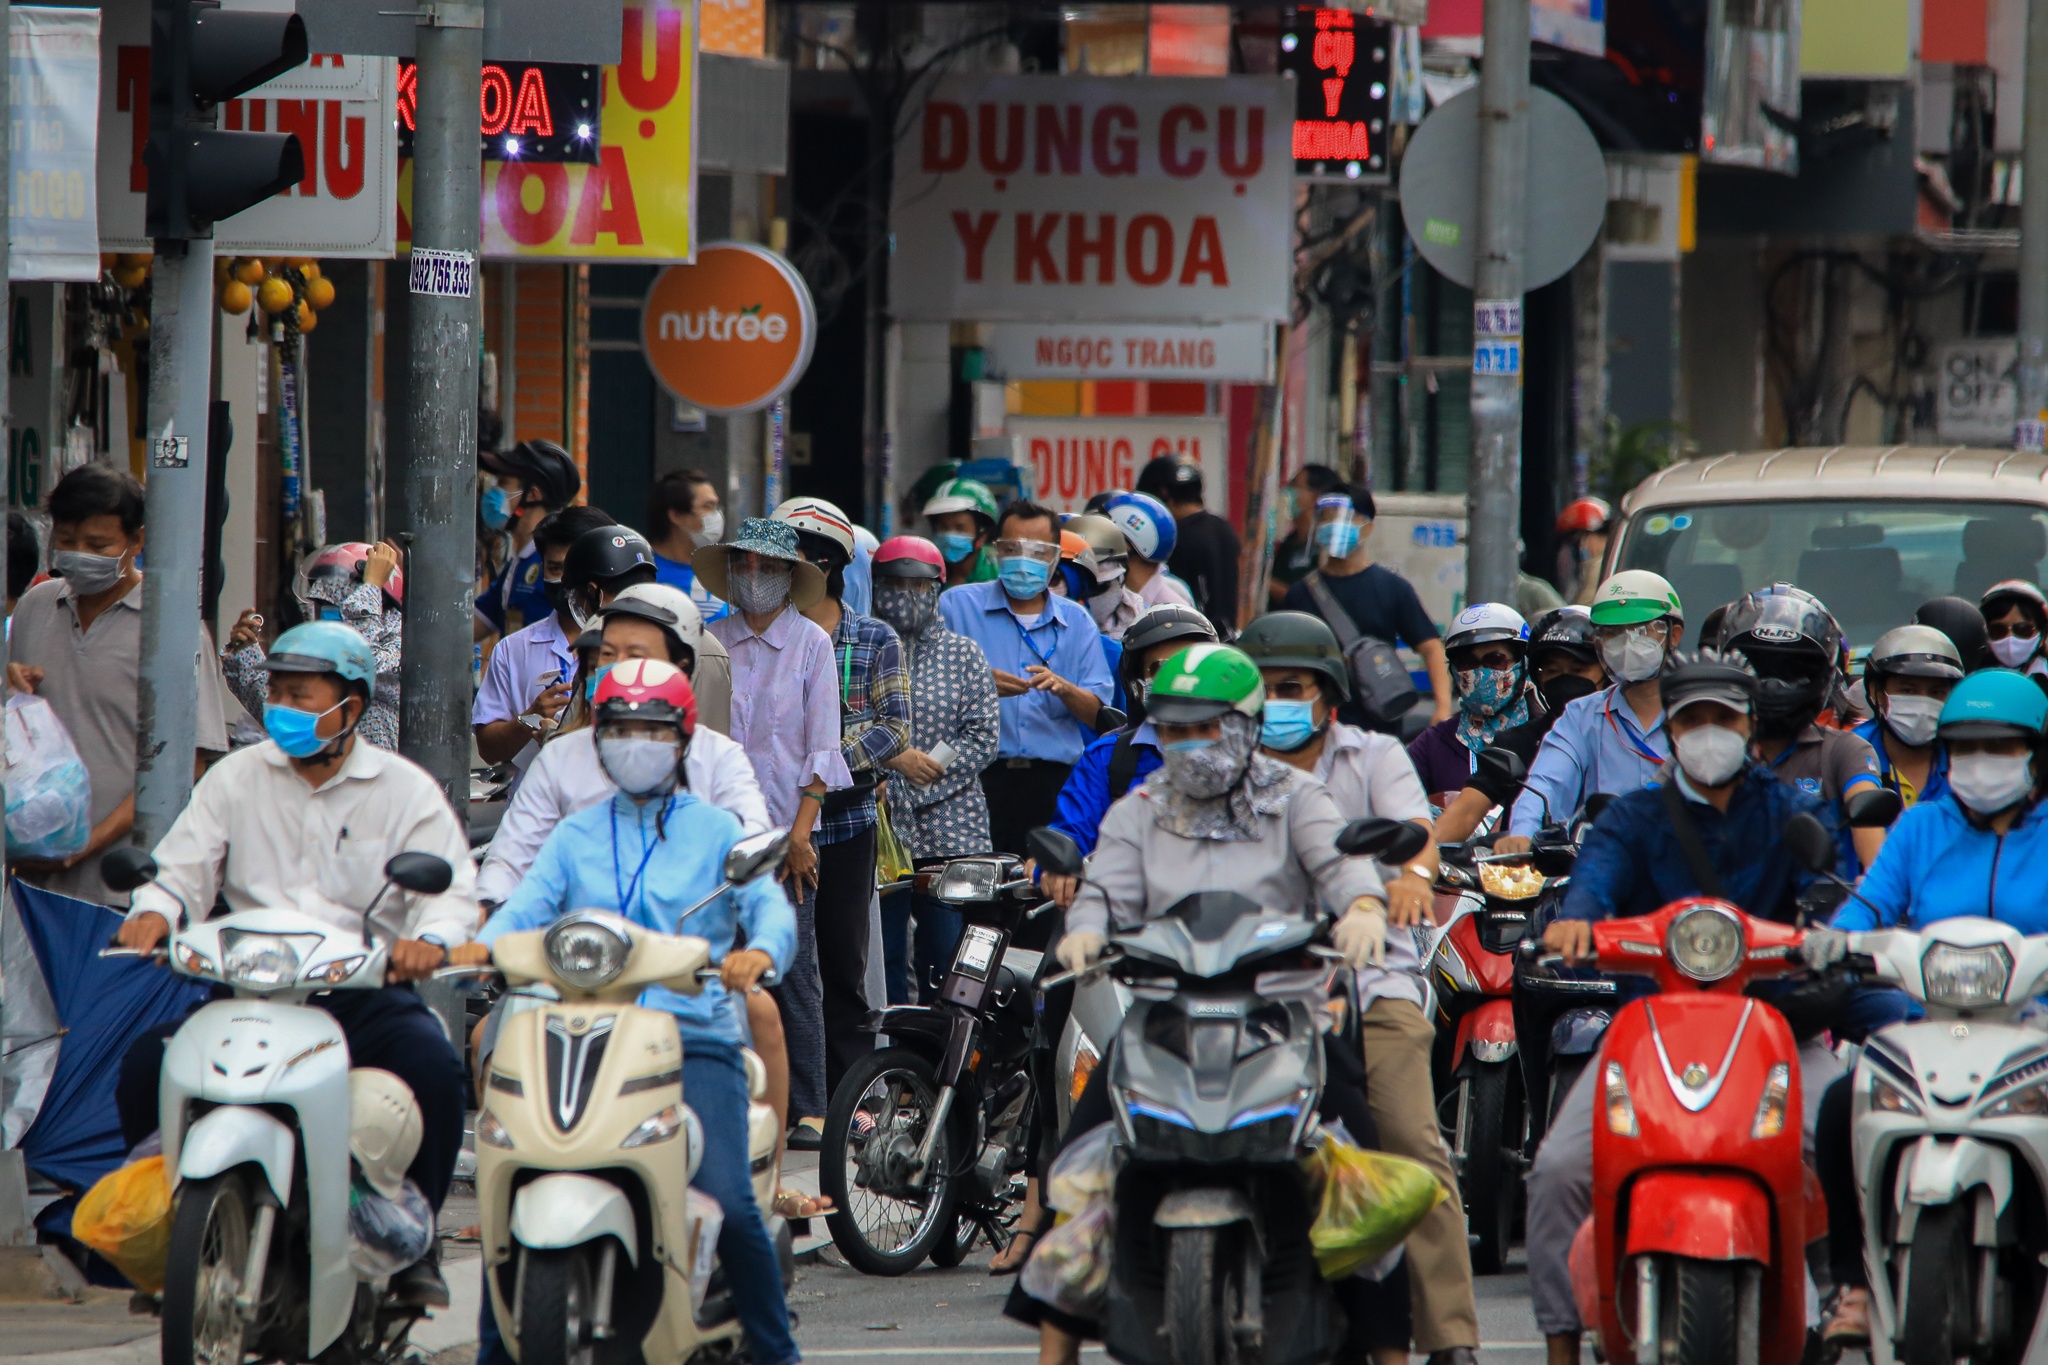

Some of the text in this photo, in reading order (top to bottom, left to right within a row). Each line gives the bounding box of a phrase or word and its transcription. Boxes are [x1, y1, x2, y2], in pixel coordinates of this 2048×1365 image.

[921, 102, 1265, 196] DỤNG CỤ
[951, 210, 1229, 287] Y KHOA
[659, 311, 788, 343] nutree
[1036, 337, 1216, 374] NGỌC TRANG
[1755, 627, 1798, 639] HJC
[1491, 912, 1527, 920] HONDA
